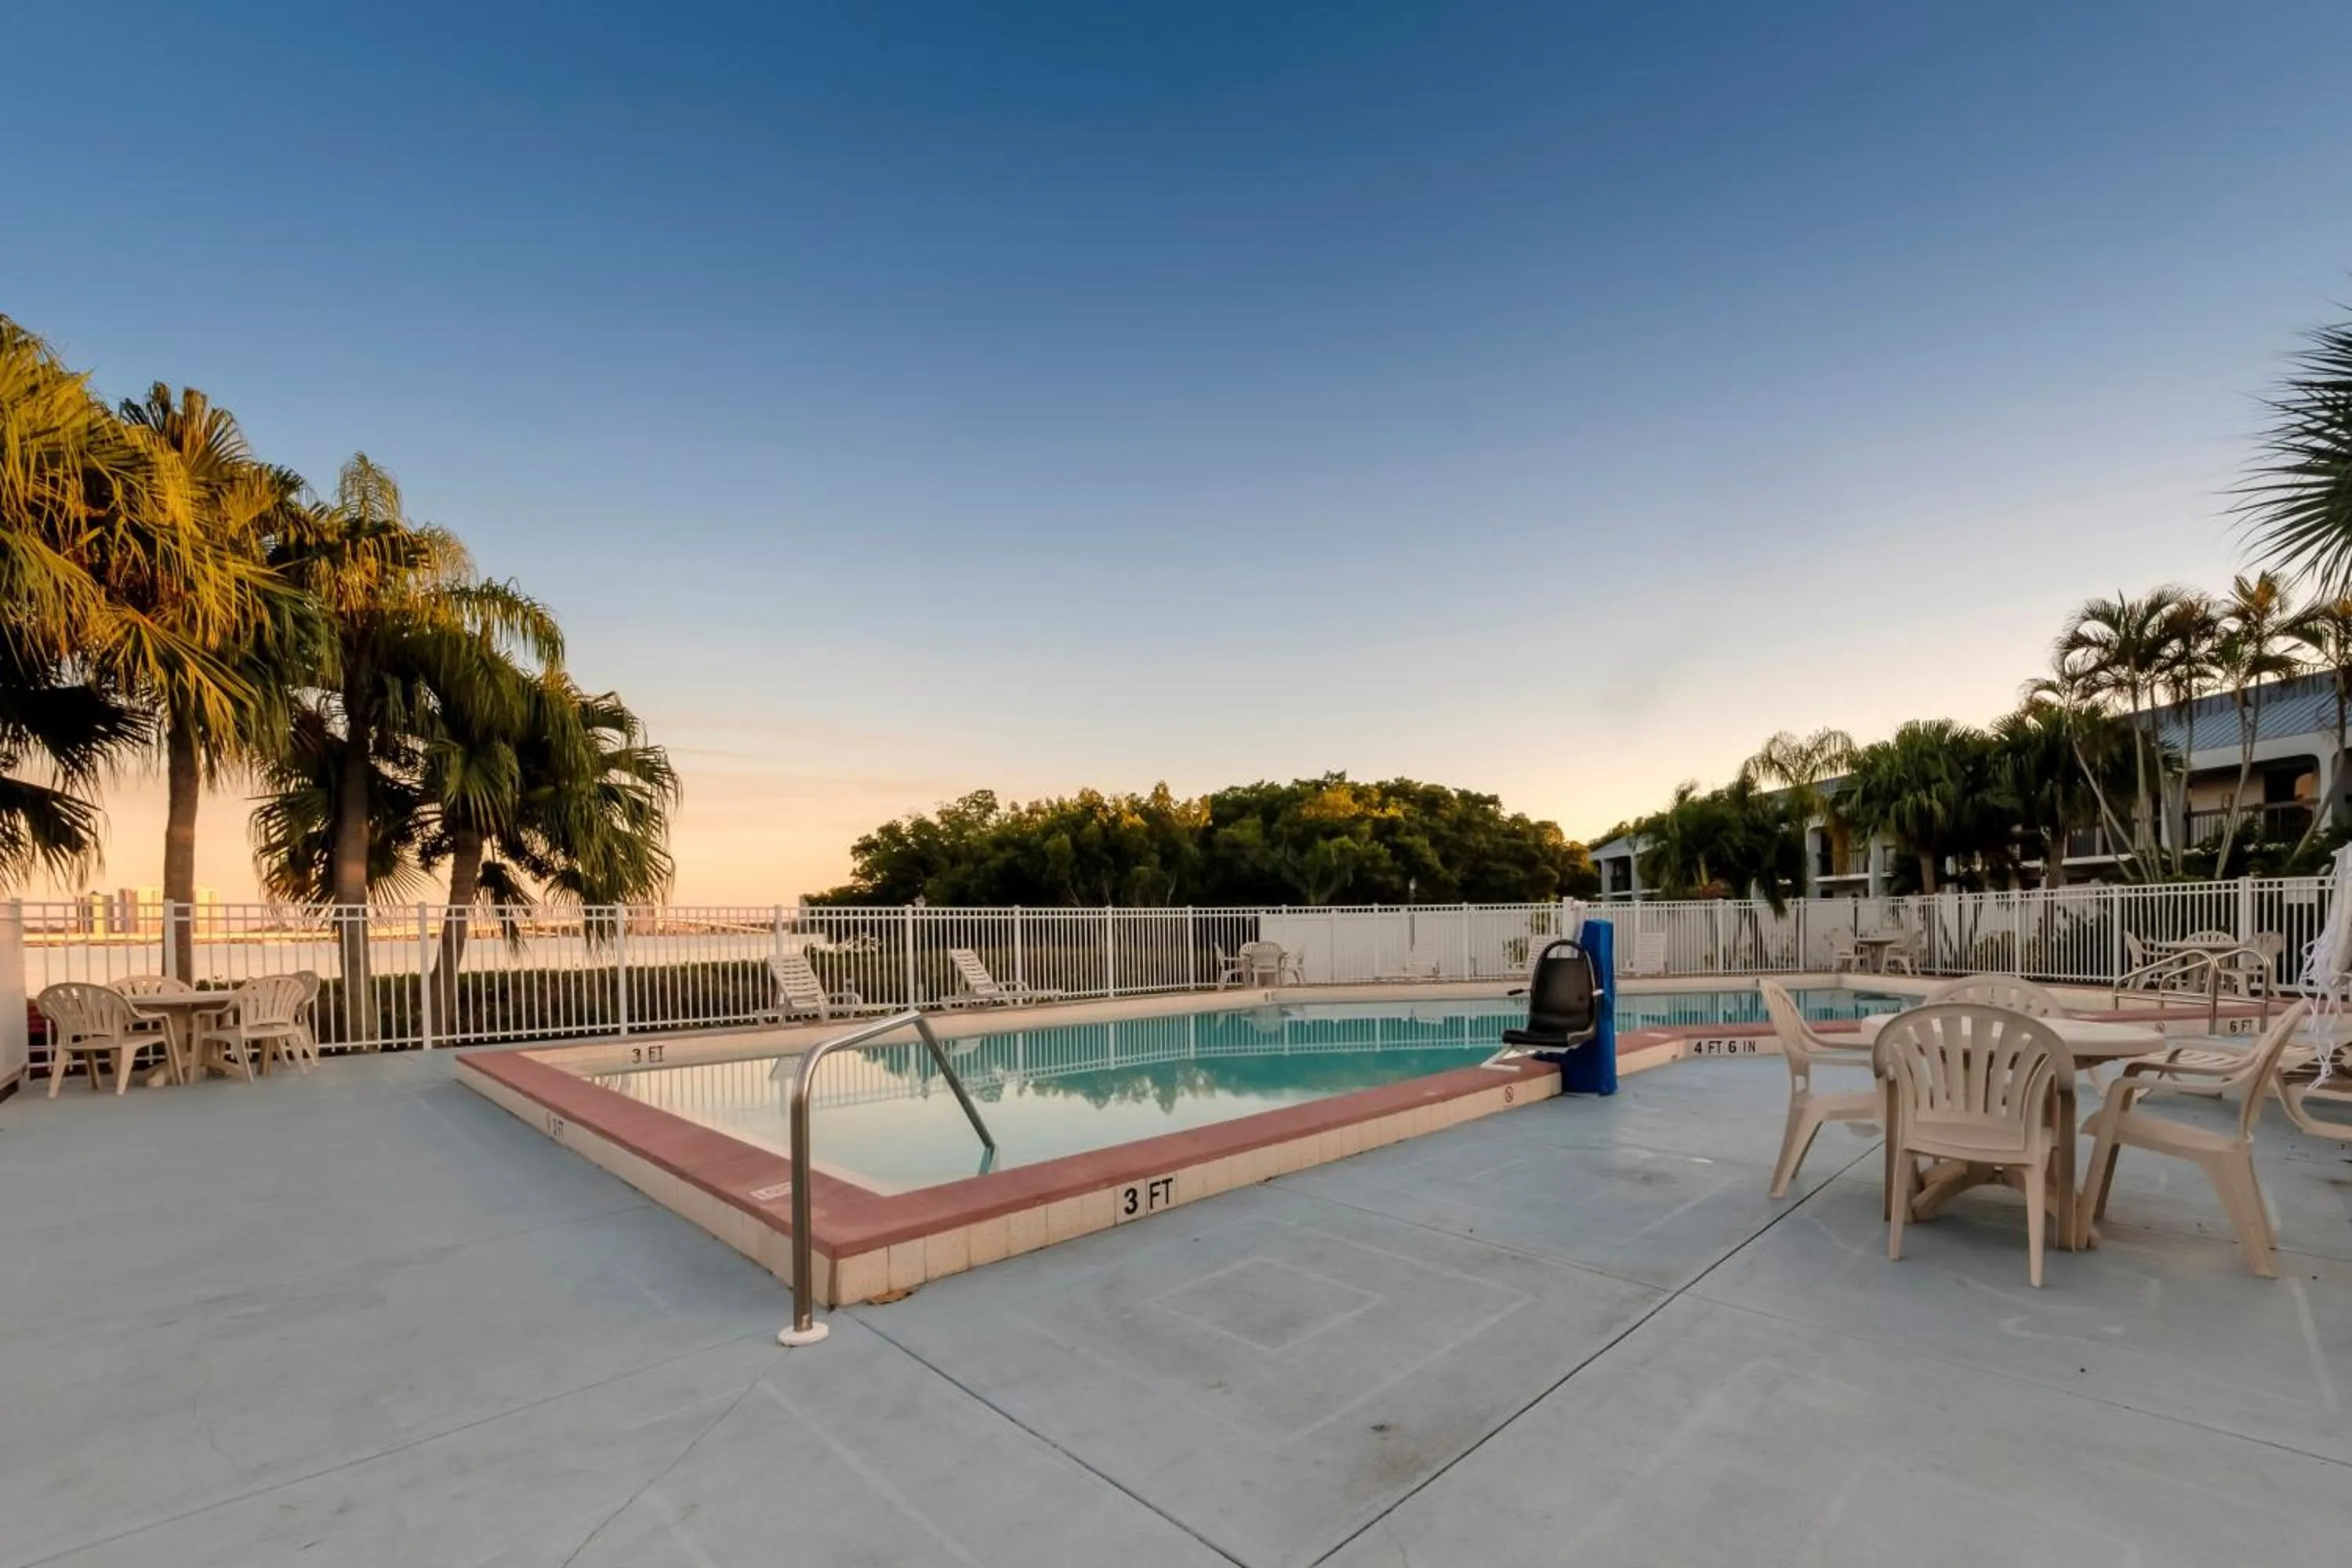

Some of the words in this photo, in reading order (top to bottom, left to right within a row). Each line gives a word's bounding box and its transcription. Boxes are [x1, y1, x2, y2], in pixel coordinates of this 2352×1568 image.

[2229, 1020, 2237, 1033] 6
[2241, 1020, 2252, 1032] FT
[632, 1048, 641, 1064] 3
[648, 1045, 665, 1063] FT
[1694, 1040, 1702, 1054] 4
[1708, 1040, 1722, 1054] FT
[1728, 1040, 1737, 1054] 6
[1743, 1040, 1755, 1054] IN
[1123, 1187, 1138, 1214] 3
[1149, 1178, 1174, 1210] FT
